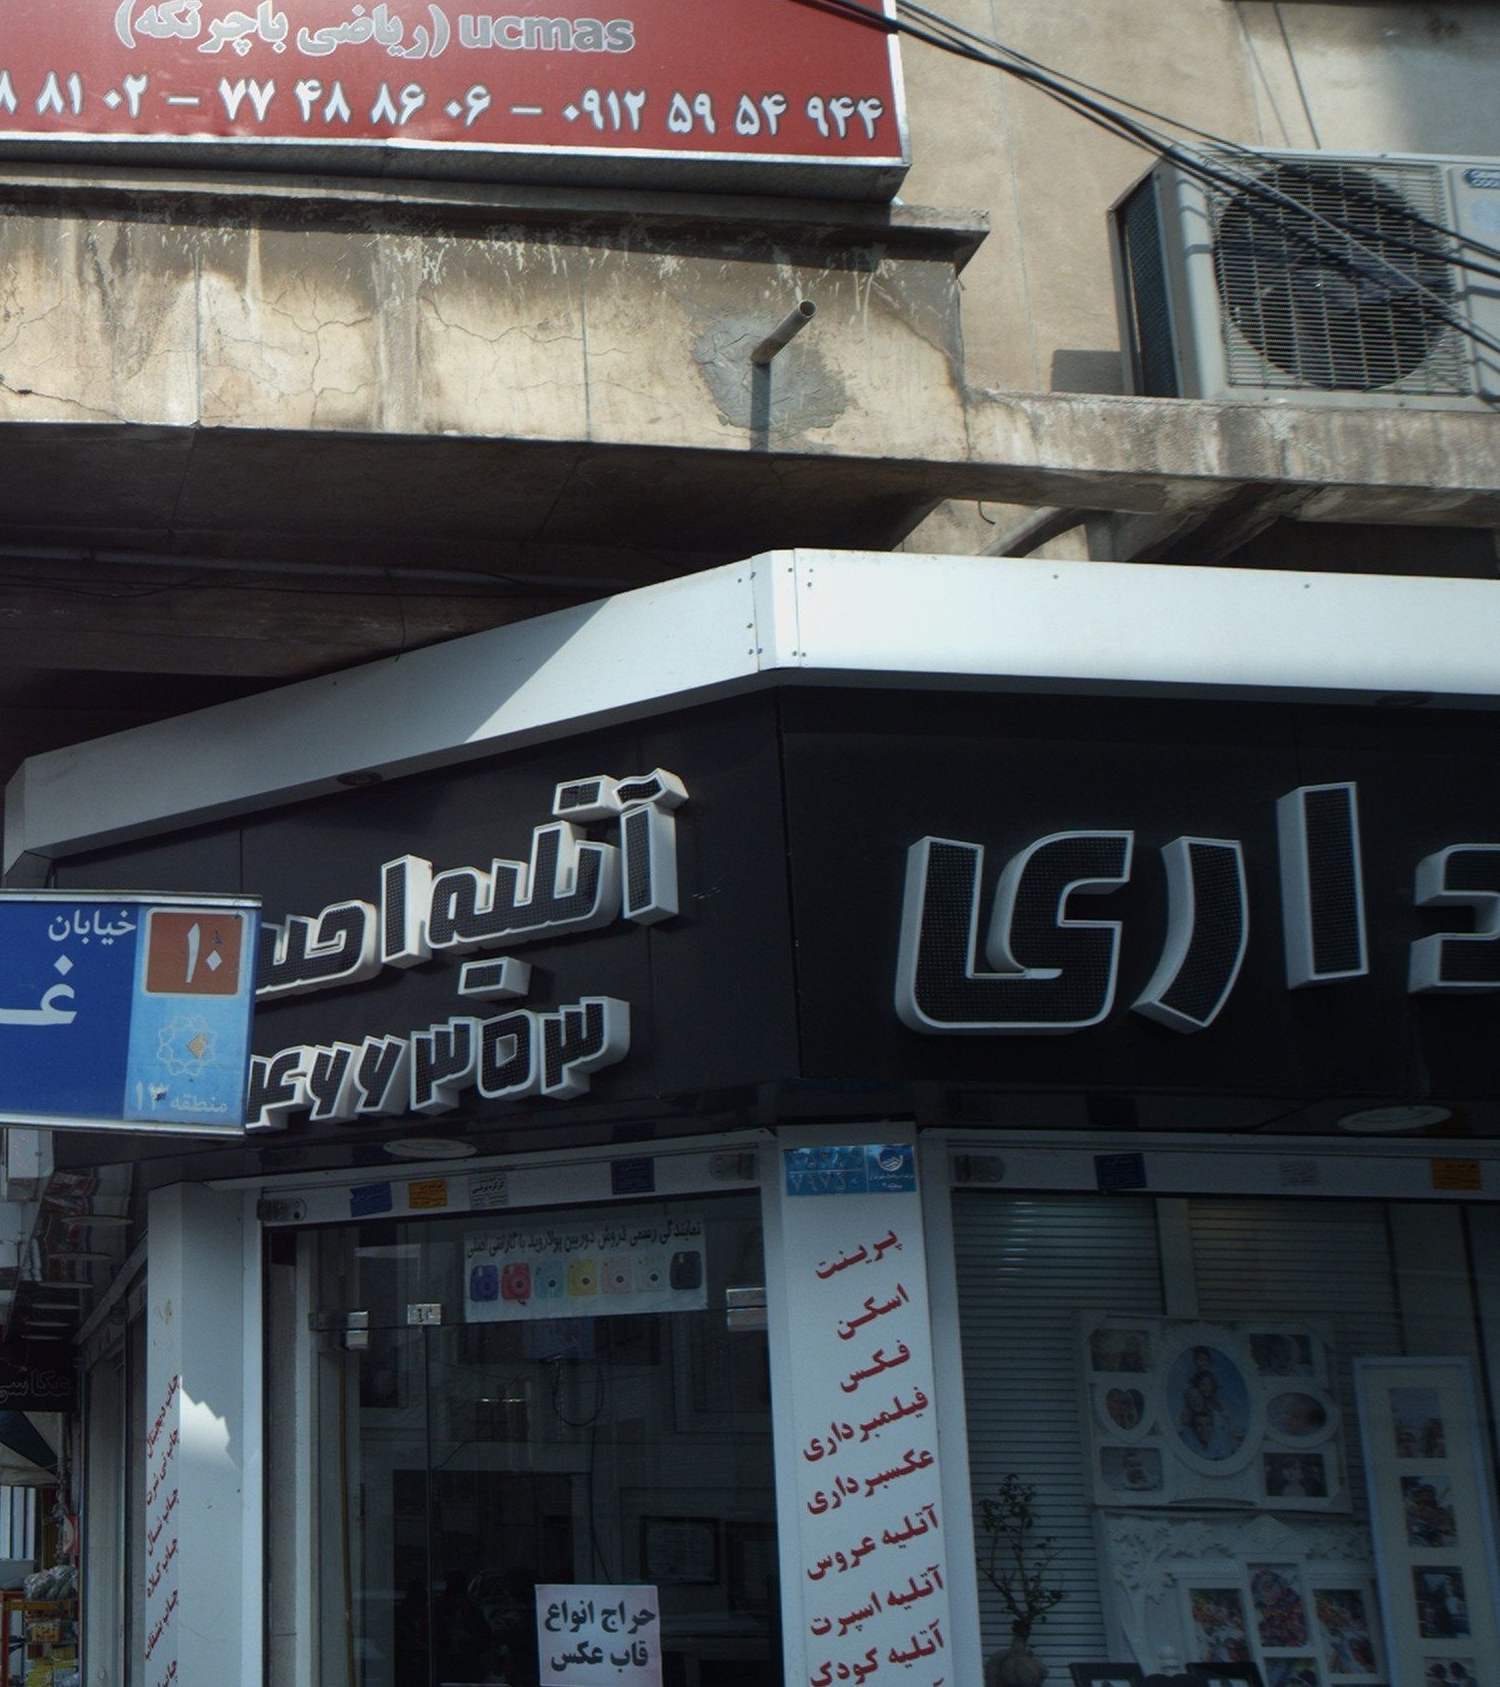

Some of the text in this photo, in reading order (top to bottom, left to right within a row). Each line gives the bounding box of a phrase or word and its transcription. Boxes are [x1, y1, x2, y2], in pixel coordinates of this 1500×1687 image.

[458, 15, 635, 53] ucmas
[36, 71, 84, 115] ۸۱
[103, 75, 150, 119] ۰۲
[218, 77, 275, 120] ۷۷
[295, 80, 350, 122] ۴۸
[370, 84, 426, 124] ۸۶
[446, 86, 492, 126] ۰۶
[562, 86, 647, 132] ۰۹۱۲
[666, 93, 716, 136] ۵۹
[735, 94, 787, 139] ۵۴
[804, 98, 883, 141] ۹۴۴
[426, 767, 689, 1000] آتلیه
[48, 908, 137, 946] خیابان
[186, 922, 223, 984] ۱۰
[169, 1093, 228, 1114] منطقه
[564, 1230, 596, 1253] دوربین
[597, 1225, 627, 1251] فروش
[629, 1228, 658, 1247] رسمی
[659, 1219, 701, 1246] نمایندگی
[814, 1229, 902, 1279] پرینت
[836, 1283, 910, 1339] اسکن
[840, 1339, 911, 1392] فکس
[165, 1374, 179, 1408] چاپ
[803, 1385, 929, 1462] فیلمبرداری
[165, 1429, 179, 1459] چاپ
[806, 1447, 935, 1515] عکسبرداری
[163, 1488, 179, 1525] چاپ
[163, 1538, 179, 1573] چاپ
[806, 1502, 939, 1580] آتلیه عروس
[163, 1590, 179, 1624] چاپ
[544, 1600, 656, 1634] حراج انواع
[809, 1564, 944, 1636] آتلیه اسپرت
[551, 1641, 649, 1673] قاب عکس
[809, 1620, 945, 1687] آتلیه کودک
